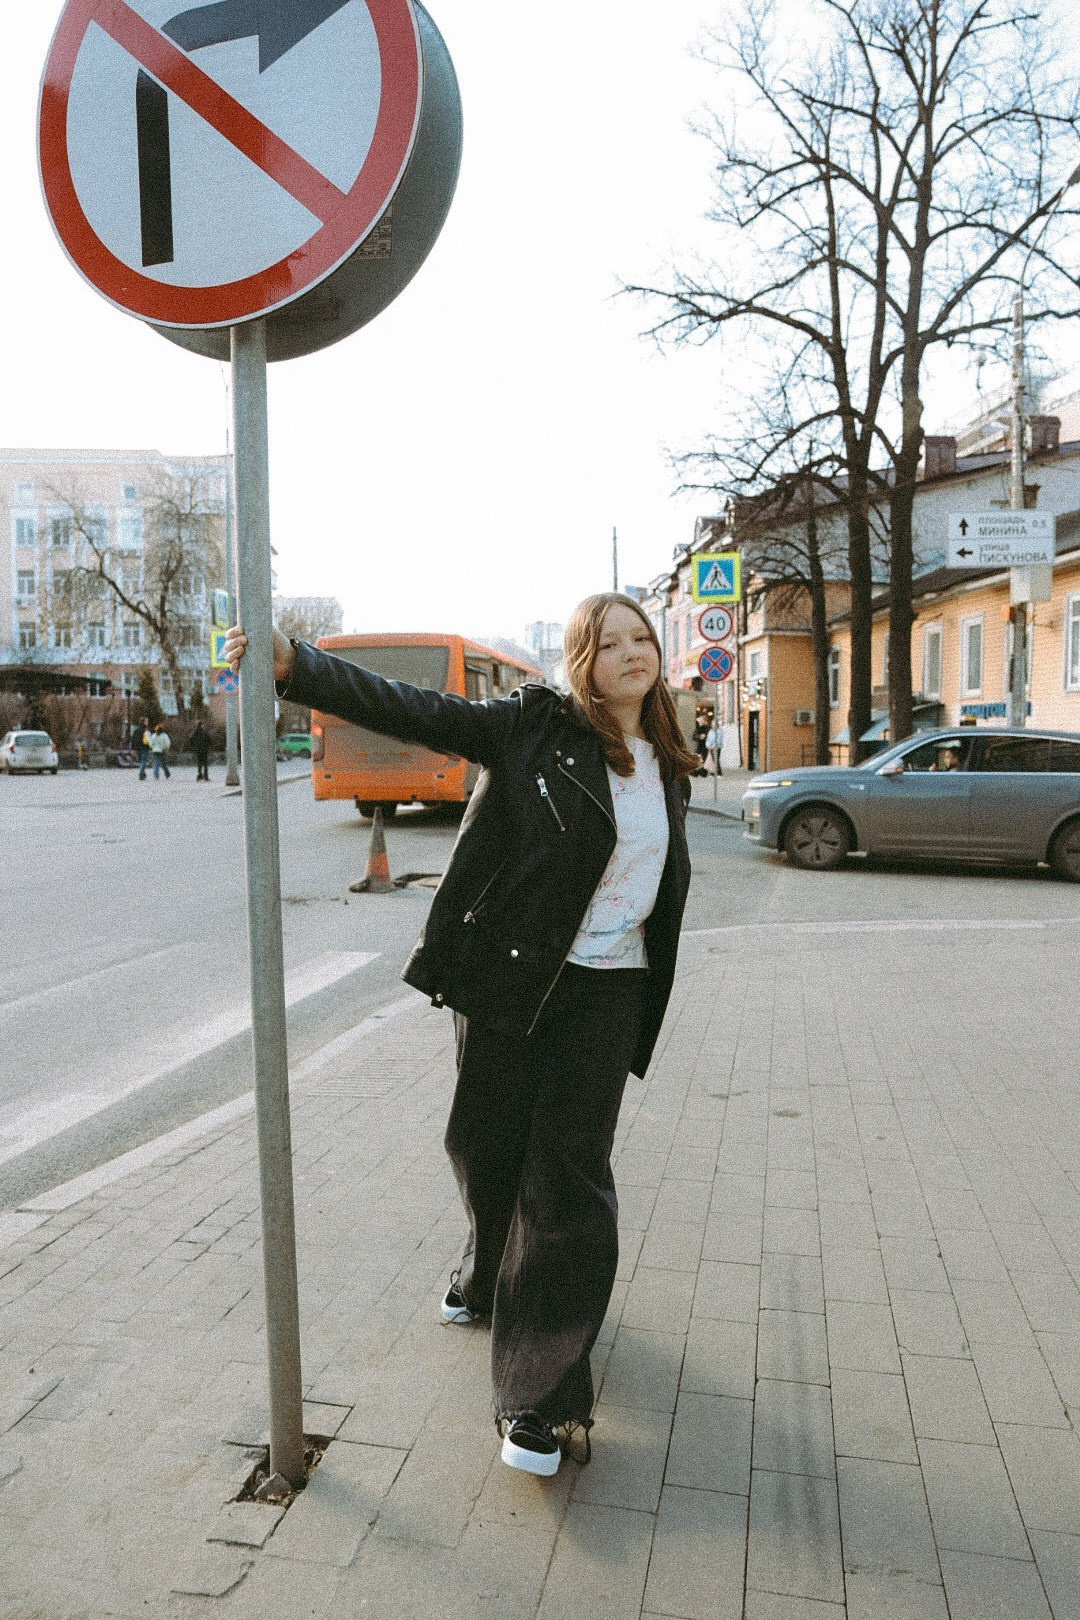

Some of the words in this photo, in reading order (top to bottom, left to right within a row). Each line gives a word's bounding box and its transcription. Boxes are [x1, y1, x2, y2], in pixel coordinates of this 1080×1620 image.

[979, 526, 1028, 536] МИНИНА
[980, 552, 1048, 563] ПИСКУНОВА
[705, 617, 725, 630] 40
